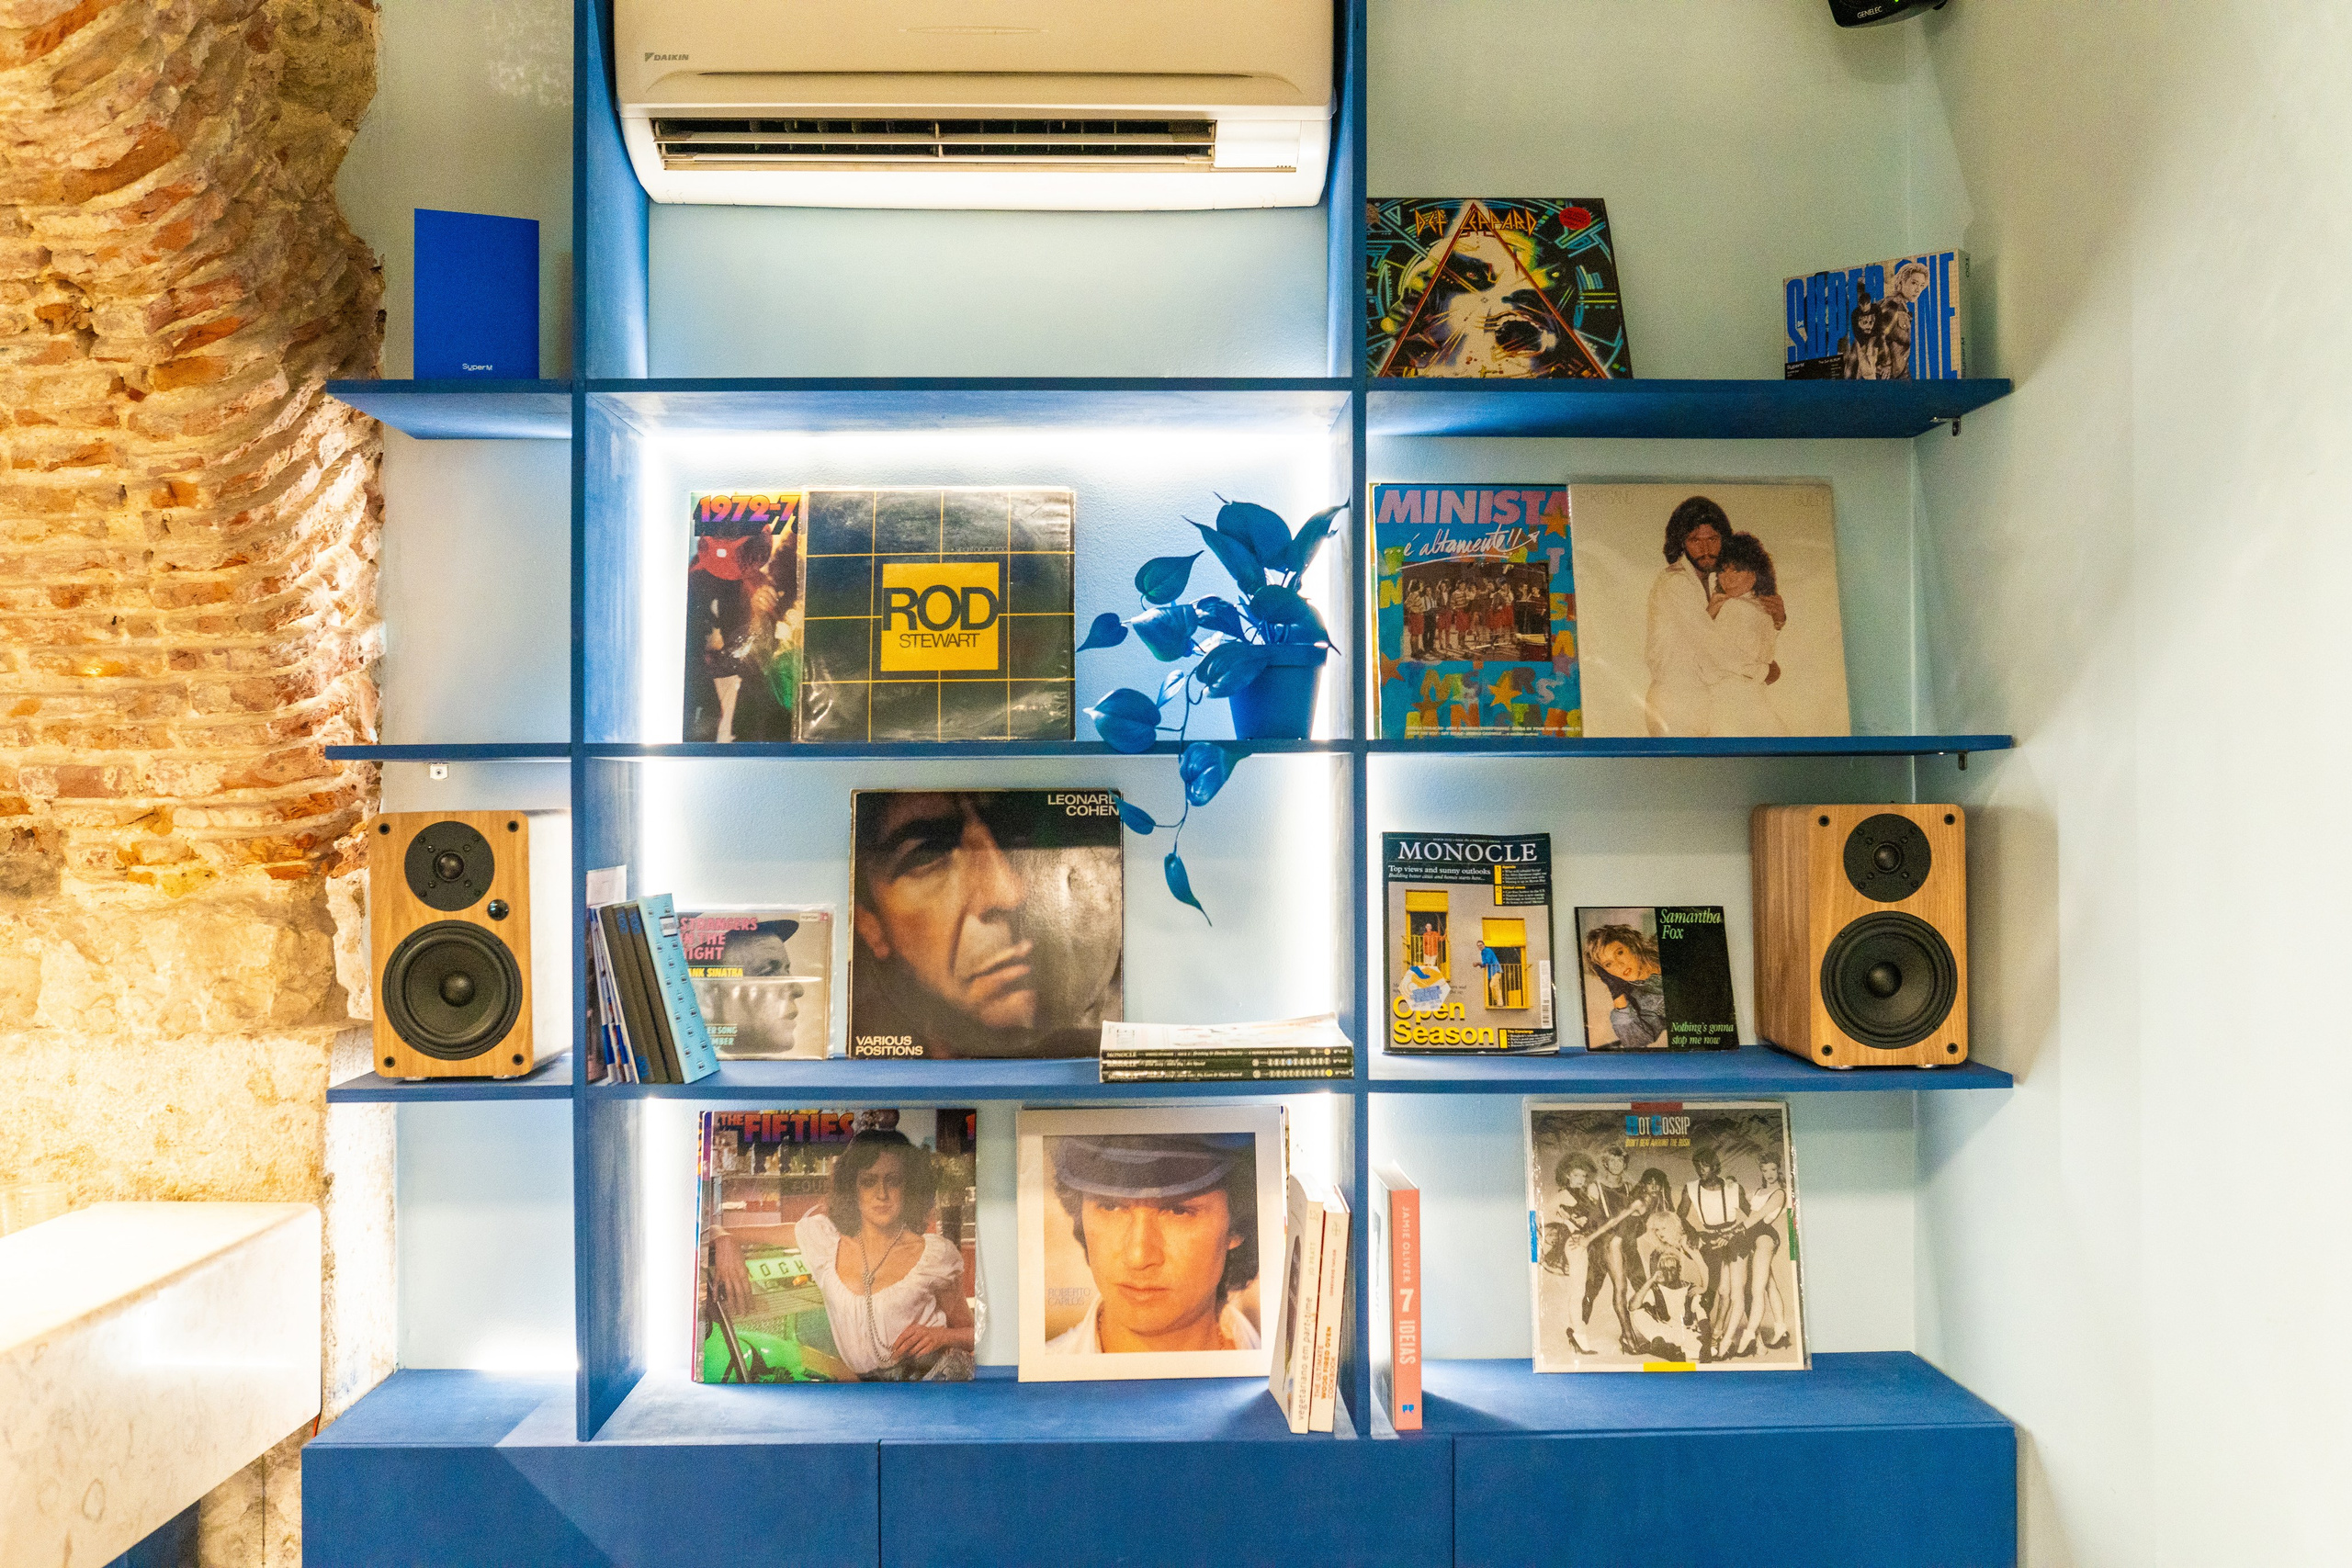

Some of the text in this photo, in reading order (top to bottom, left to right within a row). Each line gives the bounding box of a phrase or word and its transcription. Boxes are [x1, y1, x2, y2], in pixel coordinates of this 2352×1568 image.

[1857, 6, 1883, 18] GENELEC
[653, 53, 689, 62] DAIKIN
[1415, 207, 1448, 238] DEF
[1459, 206, 1538, 239] LEPPARD
[882, 583, 999, 632] ROD
[899, 633, 980, 649] STEWART
[1066, 806, 1119, 817] COHEN
[1397, 841, 1538, 863] MONOCLE
[1388, 864, 1402, 874] Top
[1425, 865, 1438, 874] and
[1439, 867, 1460, 876] sunny
[1462, 867, 1491, 875] outlooks
[680, 917, 758, 931] STRANGERS
[1659, 908, 1722, 924] Samantha
[697, 932, 726, 945] THE
[1661, 924, 1684, 940] Fox
[707, 967, 743, 978] SINATRA
[1393, 1021, 1494, 1044] Season
[1670, 1021, 1735, 1034] Nothing's gonna
[855, 1035, 912, 1046] VARIOUS
[1671, 1035, 1688, 1047] stop
[1703, 1037, 1721, 1045] now
[855, 1045, 924, 1056] POSITIONS
[719, 1112, 855, 1143] THE FIFTIES
[1625, 1115, 1690, 1136] HOT GOSSIP
[1402, 1205, 1411, 1284] JAMIE OLIVER
[1047, 1287, 1091, 1297] ROBERTO
[1047, 1296, 1086, 1306] CARLOS
[1399, 1288, 1416, 1365] 7 IDEIAS
[1298, 1296, 1313, 1420] vegetariano em part-time
[1315, 1344, 1324, 1382] ULTIMATE
[1322, 1350, 1330, 1373] FIRED
[1328, 1356, 1336, 1399] COOKBOOK
[1320, 1376, 1329, 1399] WOOD
